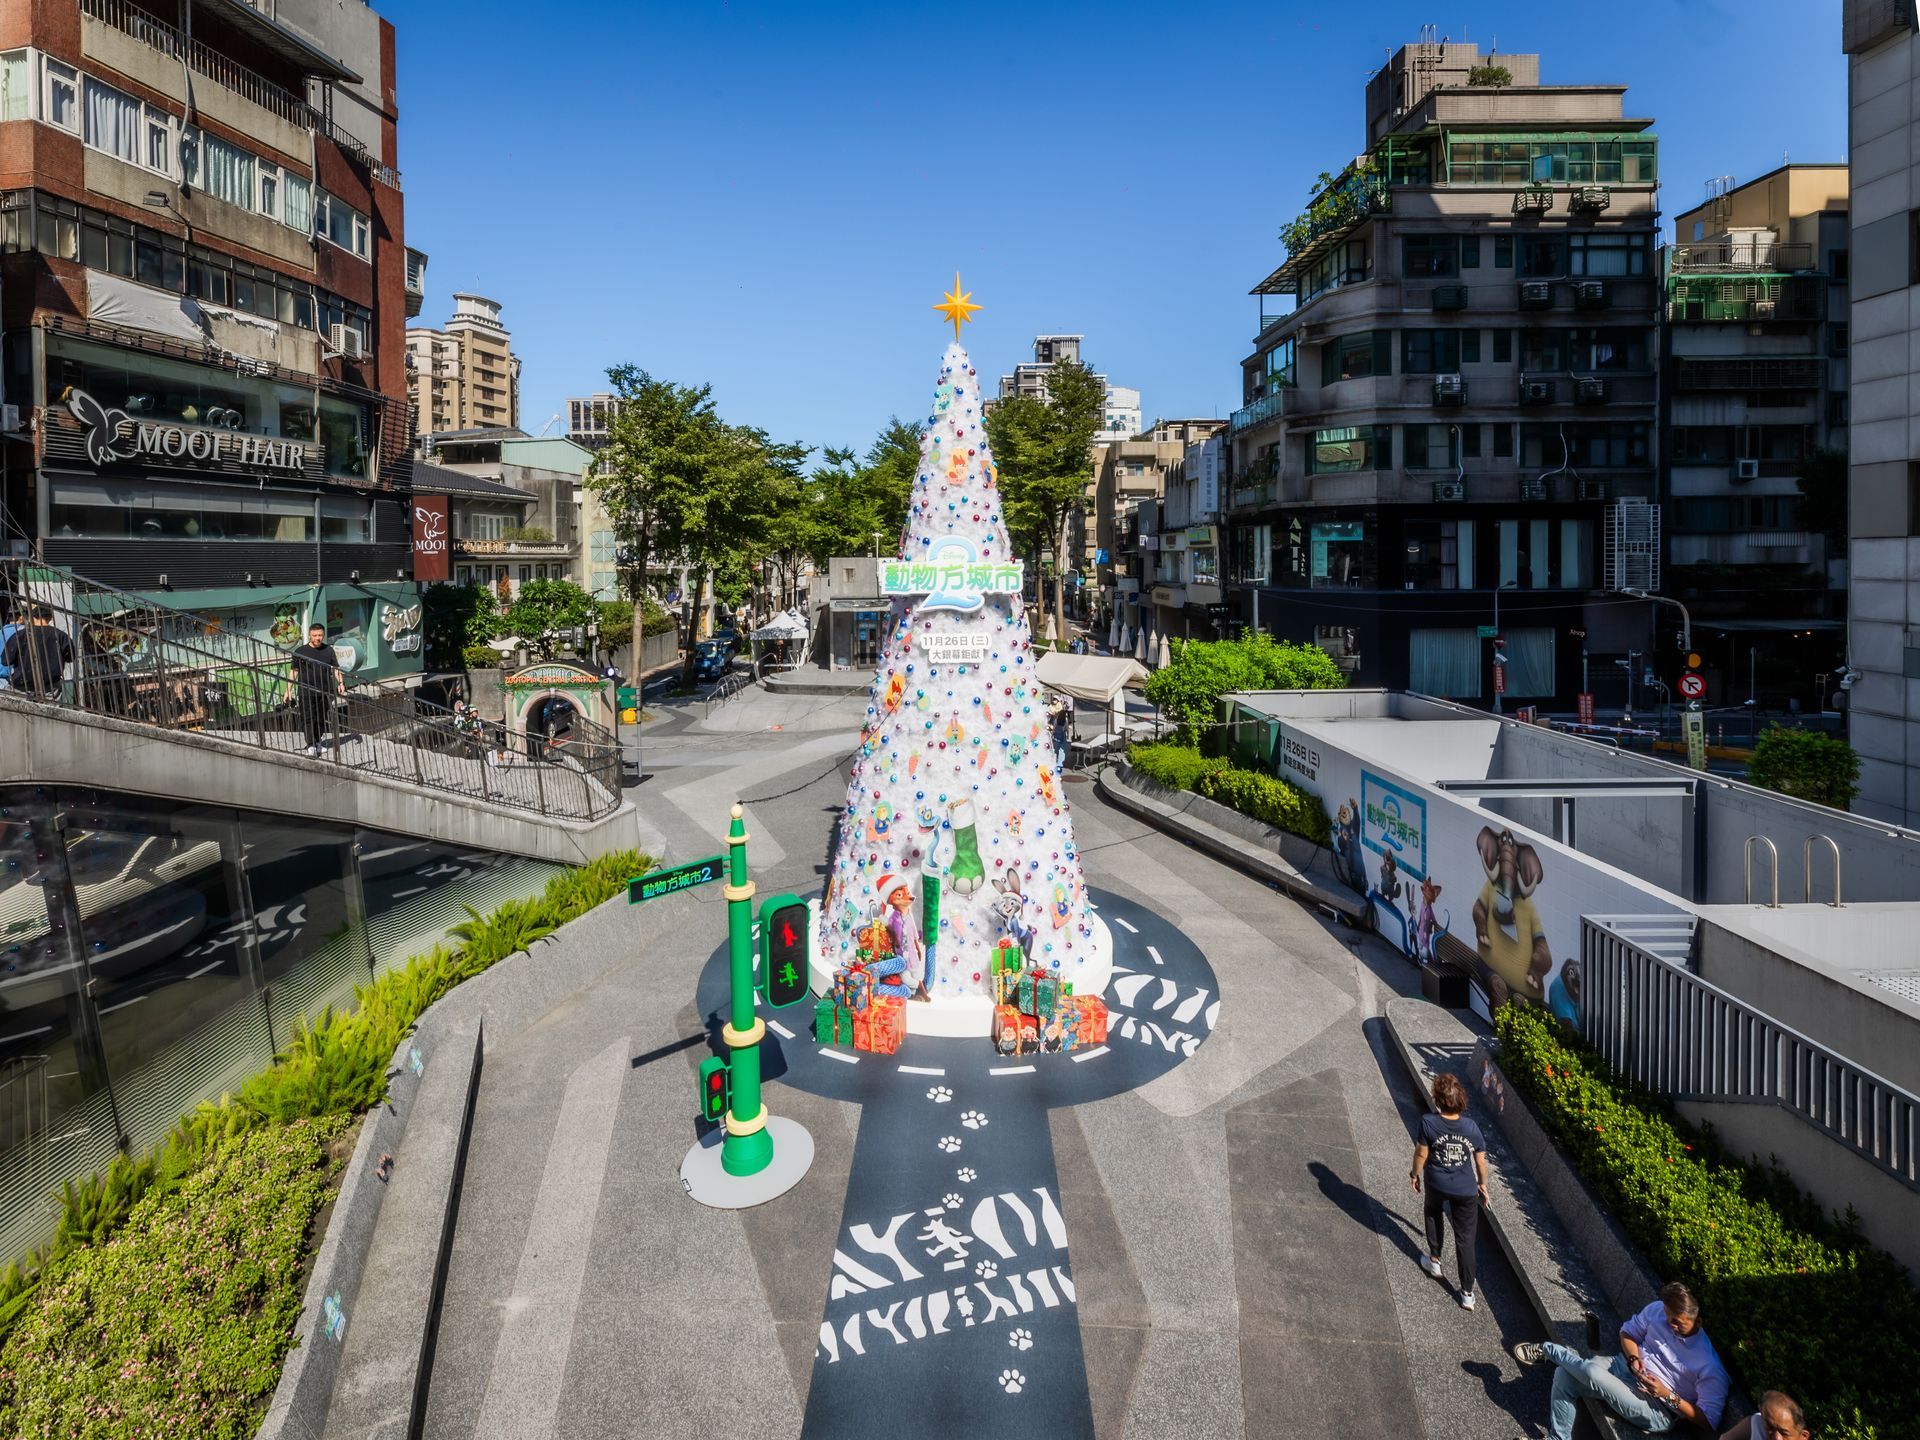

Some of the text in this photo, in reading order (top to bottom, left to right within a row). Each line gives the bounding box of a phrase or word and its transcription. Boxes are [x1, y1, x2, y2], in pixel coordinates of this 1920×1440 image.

[135, 424, 304, 470] MOOI HAIR
[415, 540, 446, 550] MOOI
[884, 562, 1022, 592] 動物方城市
[505, 676, 536, 684] ZOOTOPIA
[570, 676, 599, 684] STATION
[1366, 802, 1419, 849] 動物方城市
